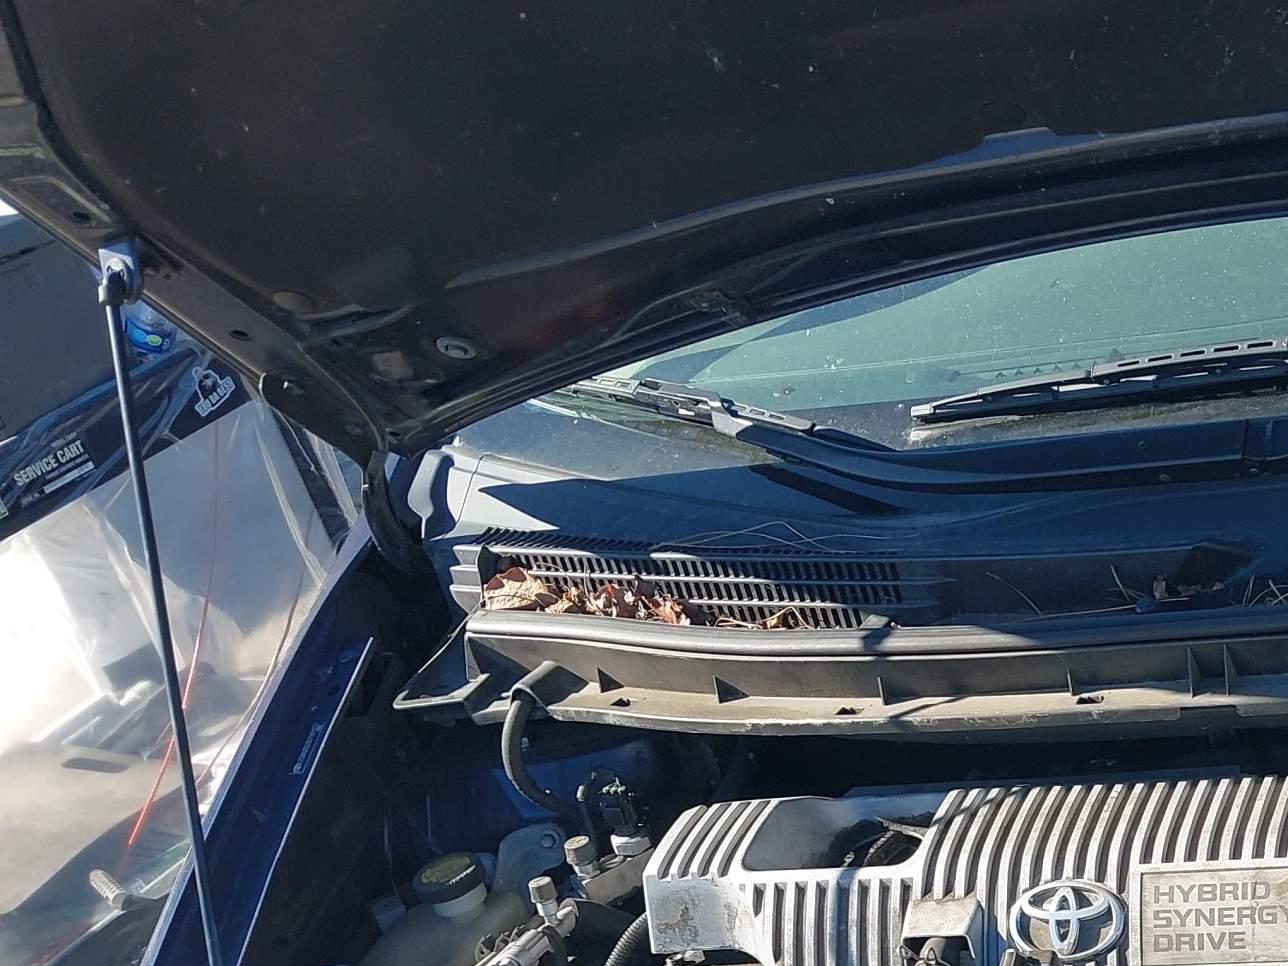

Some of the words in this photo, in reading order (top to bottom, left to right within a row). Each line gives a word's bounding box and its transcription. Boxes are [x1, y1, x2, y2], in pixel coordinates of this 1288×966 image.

[14, 454, 59, 486] SERVICE
[56, 439, 84, 463] CART
[1153, 881, 1271, 904] HYBRID
[1153, 931, 1247, 953] DRIVE
